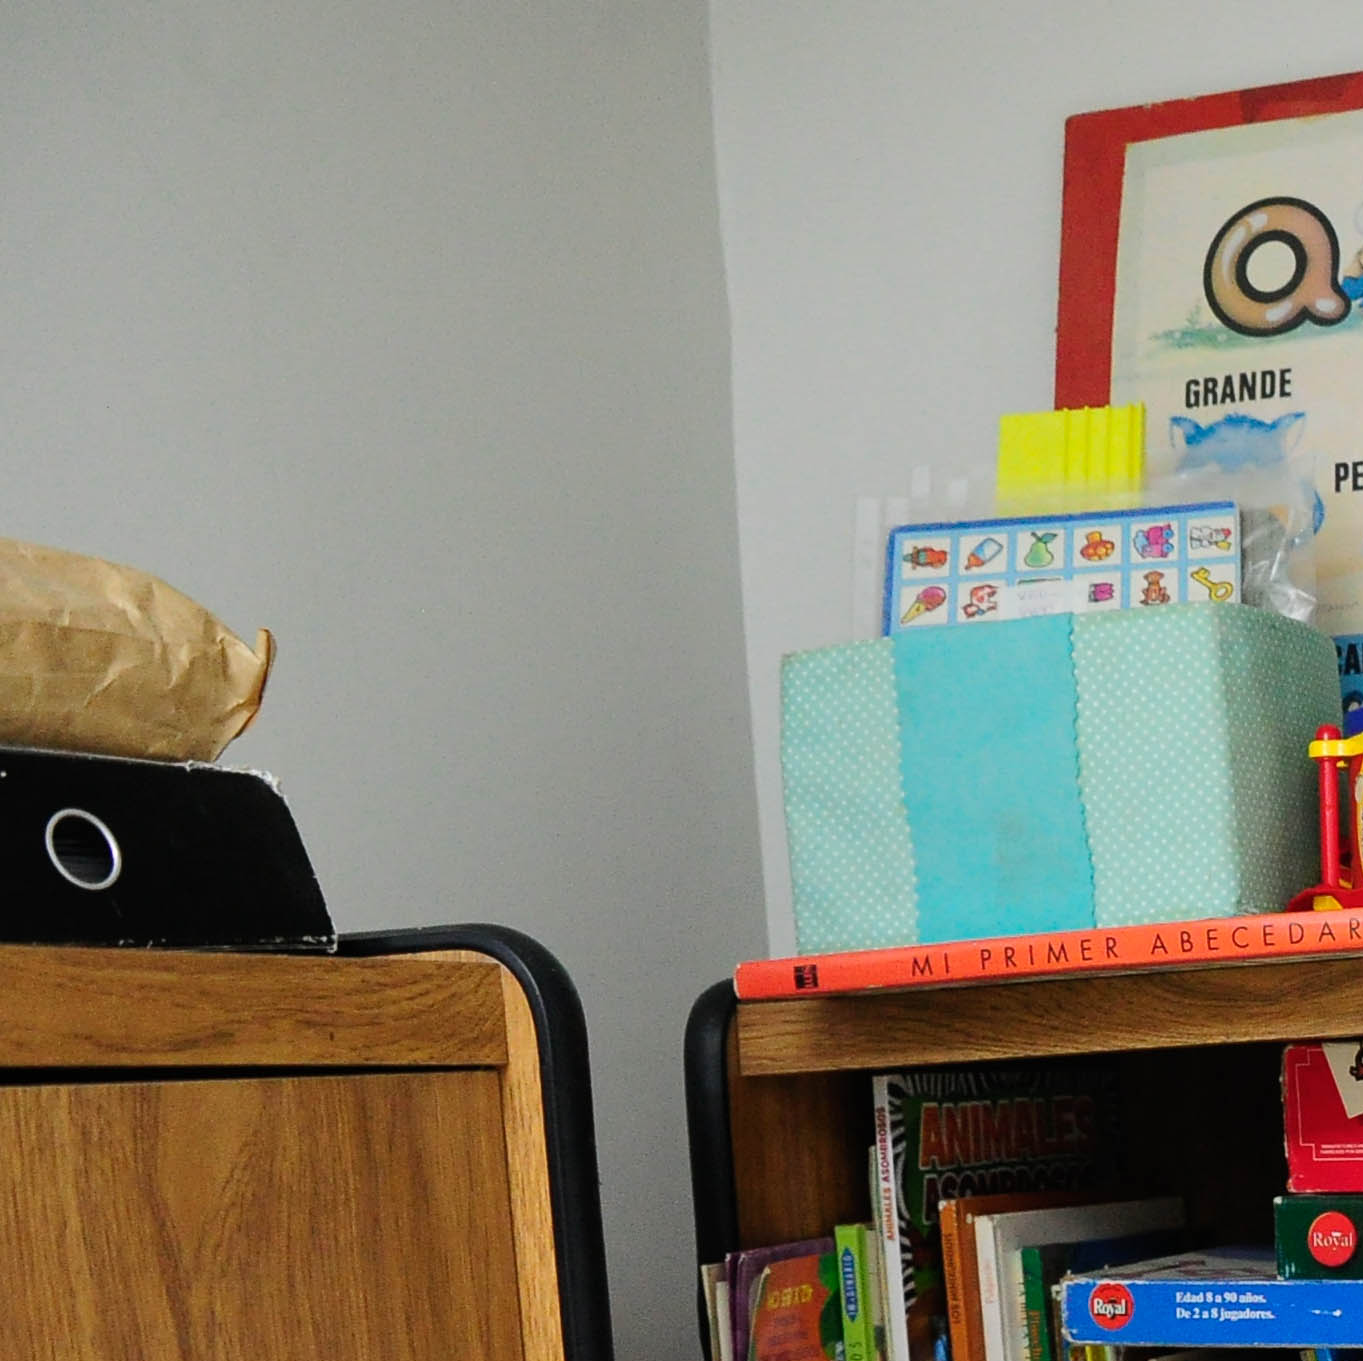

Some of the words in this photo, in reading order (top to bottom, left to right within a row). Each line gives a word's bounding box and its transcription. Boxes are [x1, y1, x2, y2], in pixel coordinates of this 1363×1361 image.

[1204, 197, 1351, 336] a
[1184, 368, 1292, 409] GRANDE
[911, 951, 950, 977] MI
[980, 935, 1120, 970] PRIMER
[875, 1106, 891, 1183] ASOMBROSOS
[883, 1187, 896, 1239] ANIMALES
[1312, 1231, 1355, 1251] Royal
[1093, 1298, 1126, 1319] Royal
[1176, 1292, 1204, 1303] Edad
[1224, 1292, 1237, 1303] 90
[1239, 1292, 1267, 1303] años.
[1176, 1308, 1190, 1319] De
[1193, 1309, 1199, 1319] 2
[1220, 1308, 1275, 1321] jugadores.
